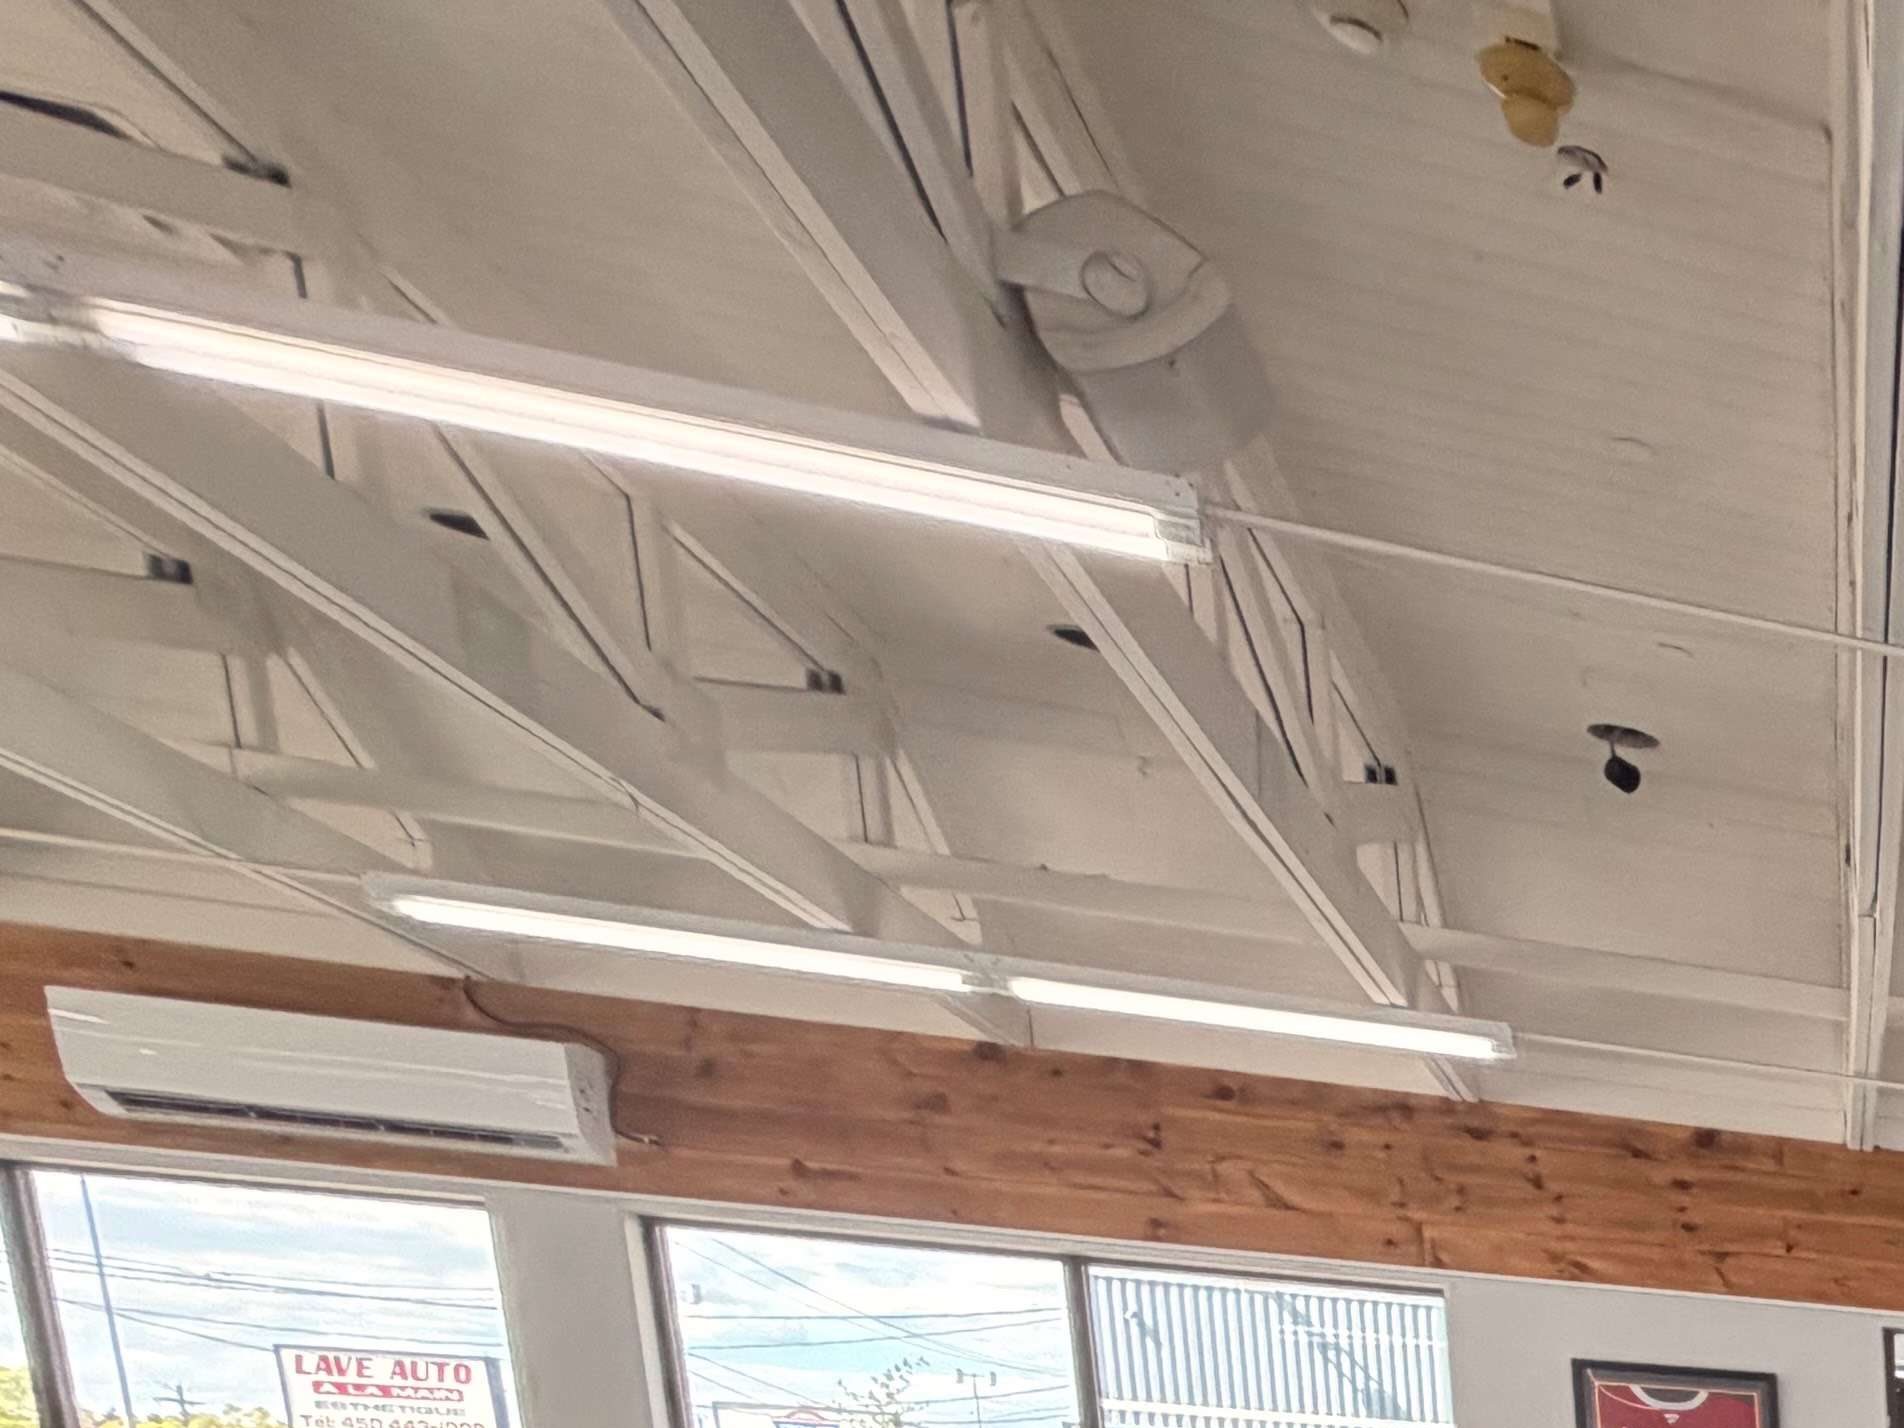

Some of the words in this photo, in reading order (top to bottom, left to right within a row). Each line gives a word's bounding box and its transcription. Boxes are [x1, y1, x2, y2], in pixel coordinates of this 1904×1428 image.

[295, 1354, 374, 1378] LAVE
[389, 1359, 472, 1384] AUTO
[347, 1384, 384, 1396] LA
[391, 1387, 463, 1401] MAIN
